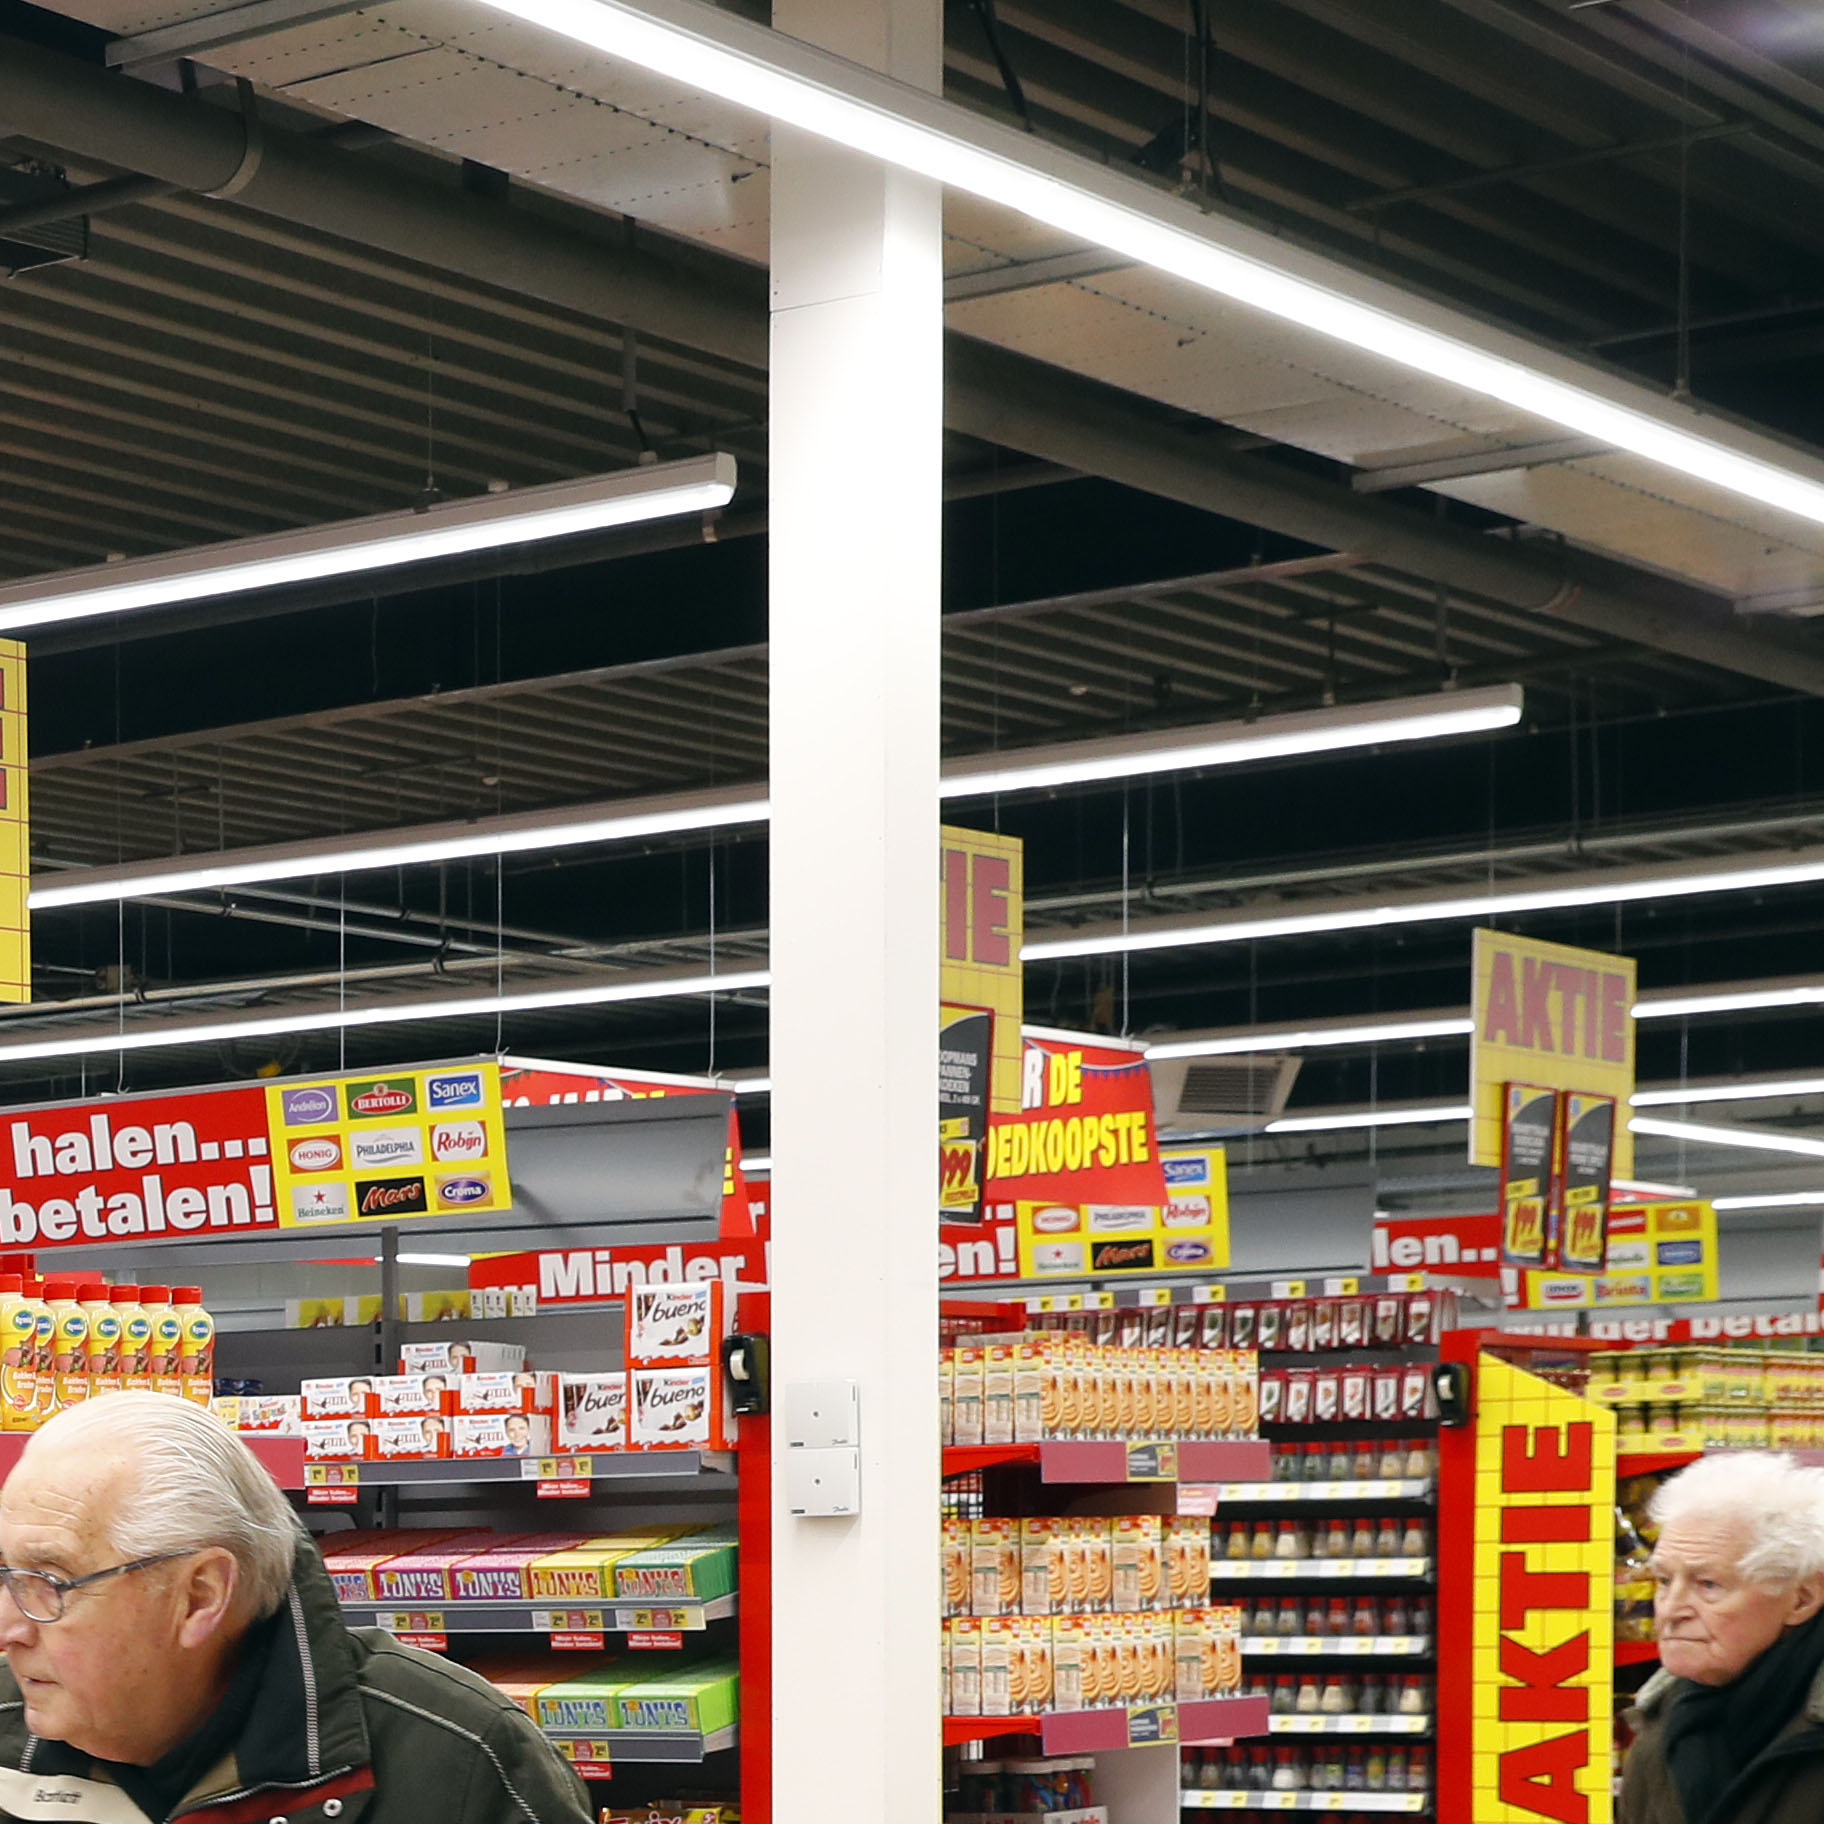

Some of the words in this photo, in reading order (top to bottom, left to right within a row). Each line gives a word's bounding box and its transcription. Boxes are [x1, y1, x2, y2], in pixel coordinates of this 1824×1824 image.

[1484, 951, 1627, 1064] AKTIE
[357, 1094, 407, 1110] BERTOLLI
[432, 1080, 478, 1100] Sanex
[1049, 1050, 1083, 1107] DE
[10, 1114, 268, 1179] halen...
[298, 1148, 333, 1160] HONIG
[356, 1141, 415, 1158] PHILADELPHIA
[437, 1130, 482, 1151] Robijn
[297, 1205, 345, 1219] Heineken
[361, 1182, 422, 1213] Mars
[443, 1184, 483, 1197] Croma
[650, 1384, 705, 1408] bueno
